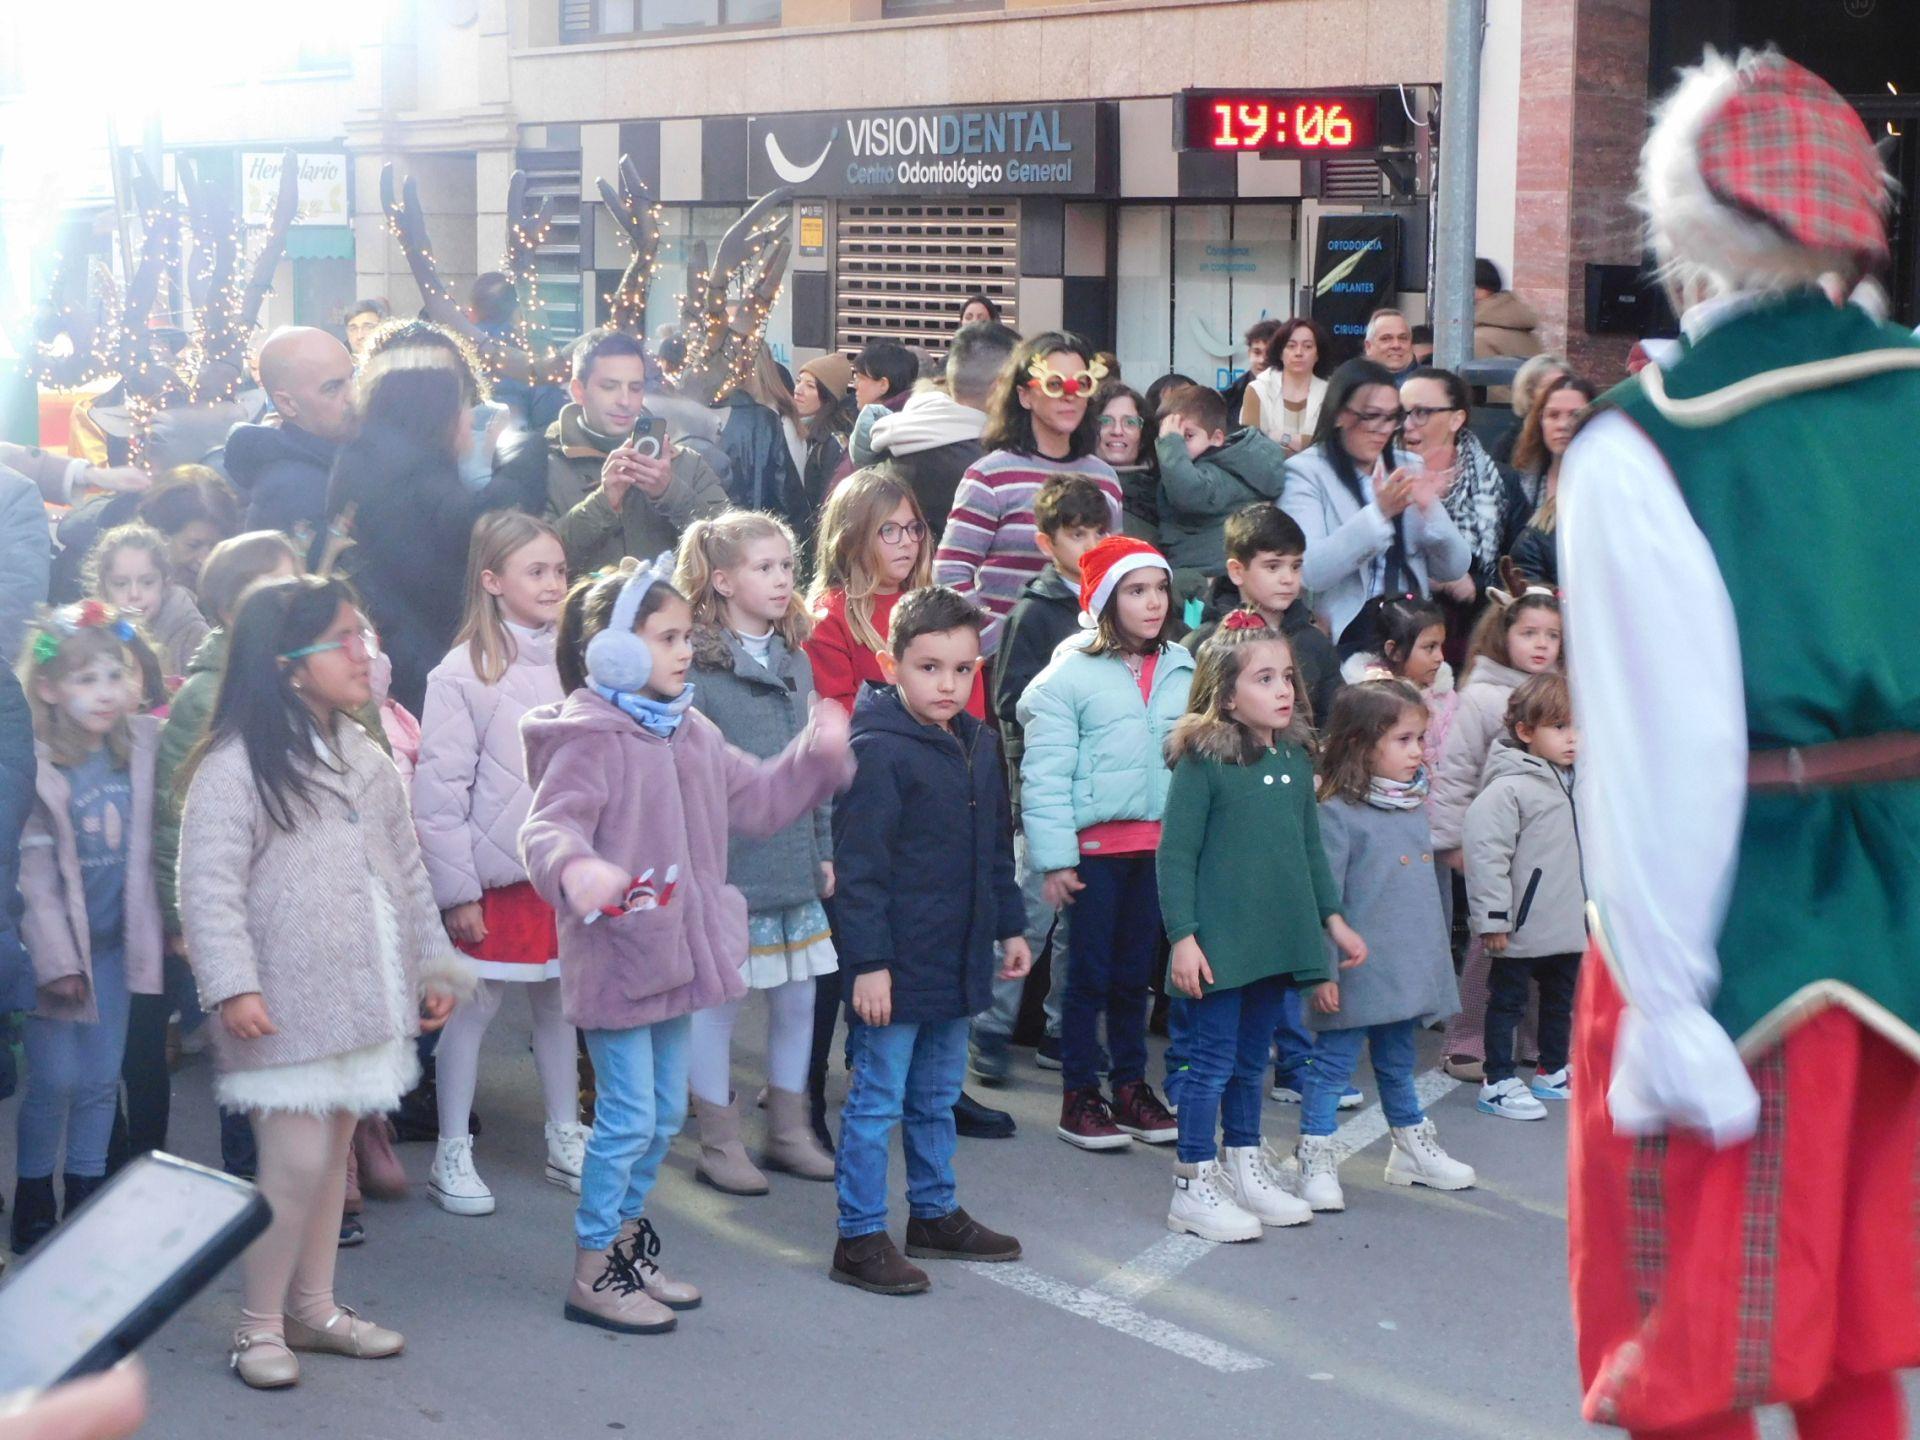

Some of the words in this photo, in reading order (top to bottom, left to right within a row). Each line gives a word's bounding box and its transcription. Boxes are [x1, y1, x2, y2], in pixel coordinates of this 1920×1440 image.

[846, 110, 1072, 157] VISIONDENTAL
[1214, 105, 1353, 146] 19:06
[248, 157, 339, 182] Herlario
[847, 162, 895, 184] Centro
[897, 157, 1002, 189] Odontológico
[1006, 159, 1072, 182] General
[1331, 282, 1375, 293] IMPLANTES
